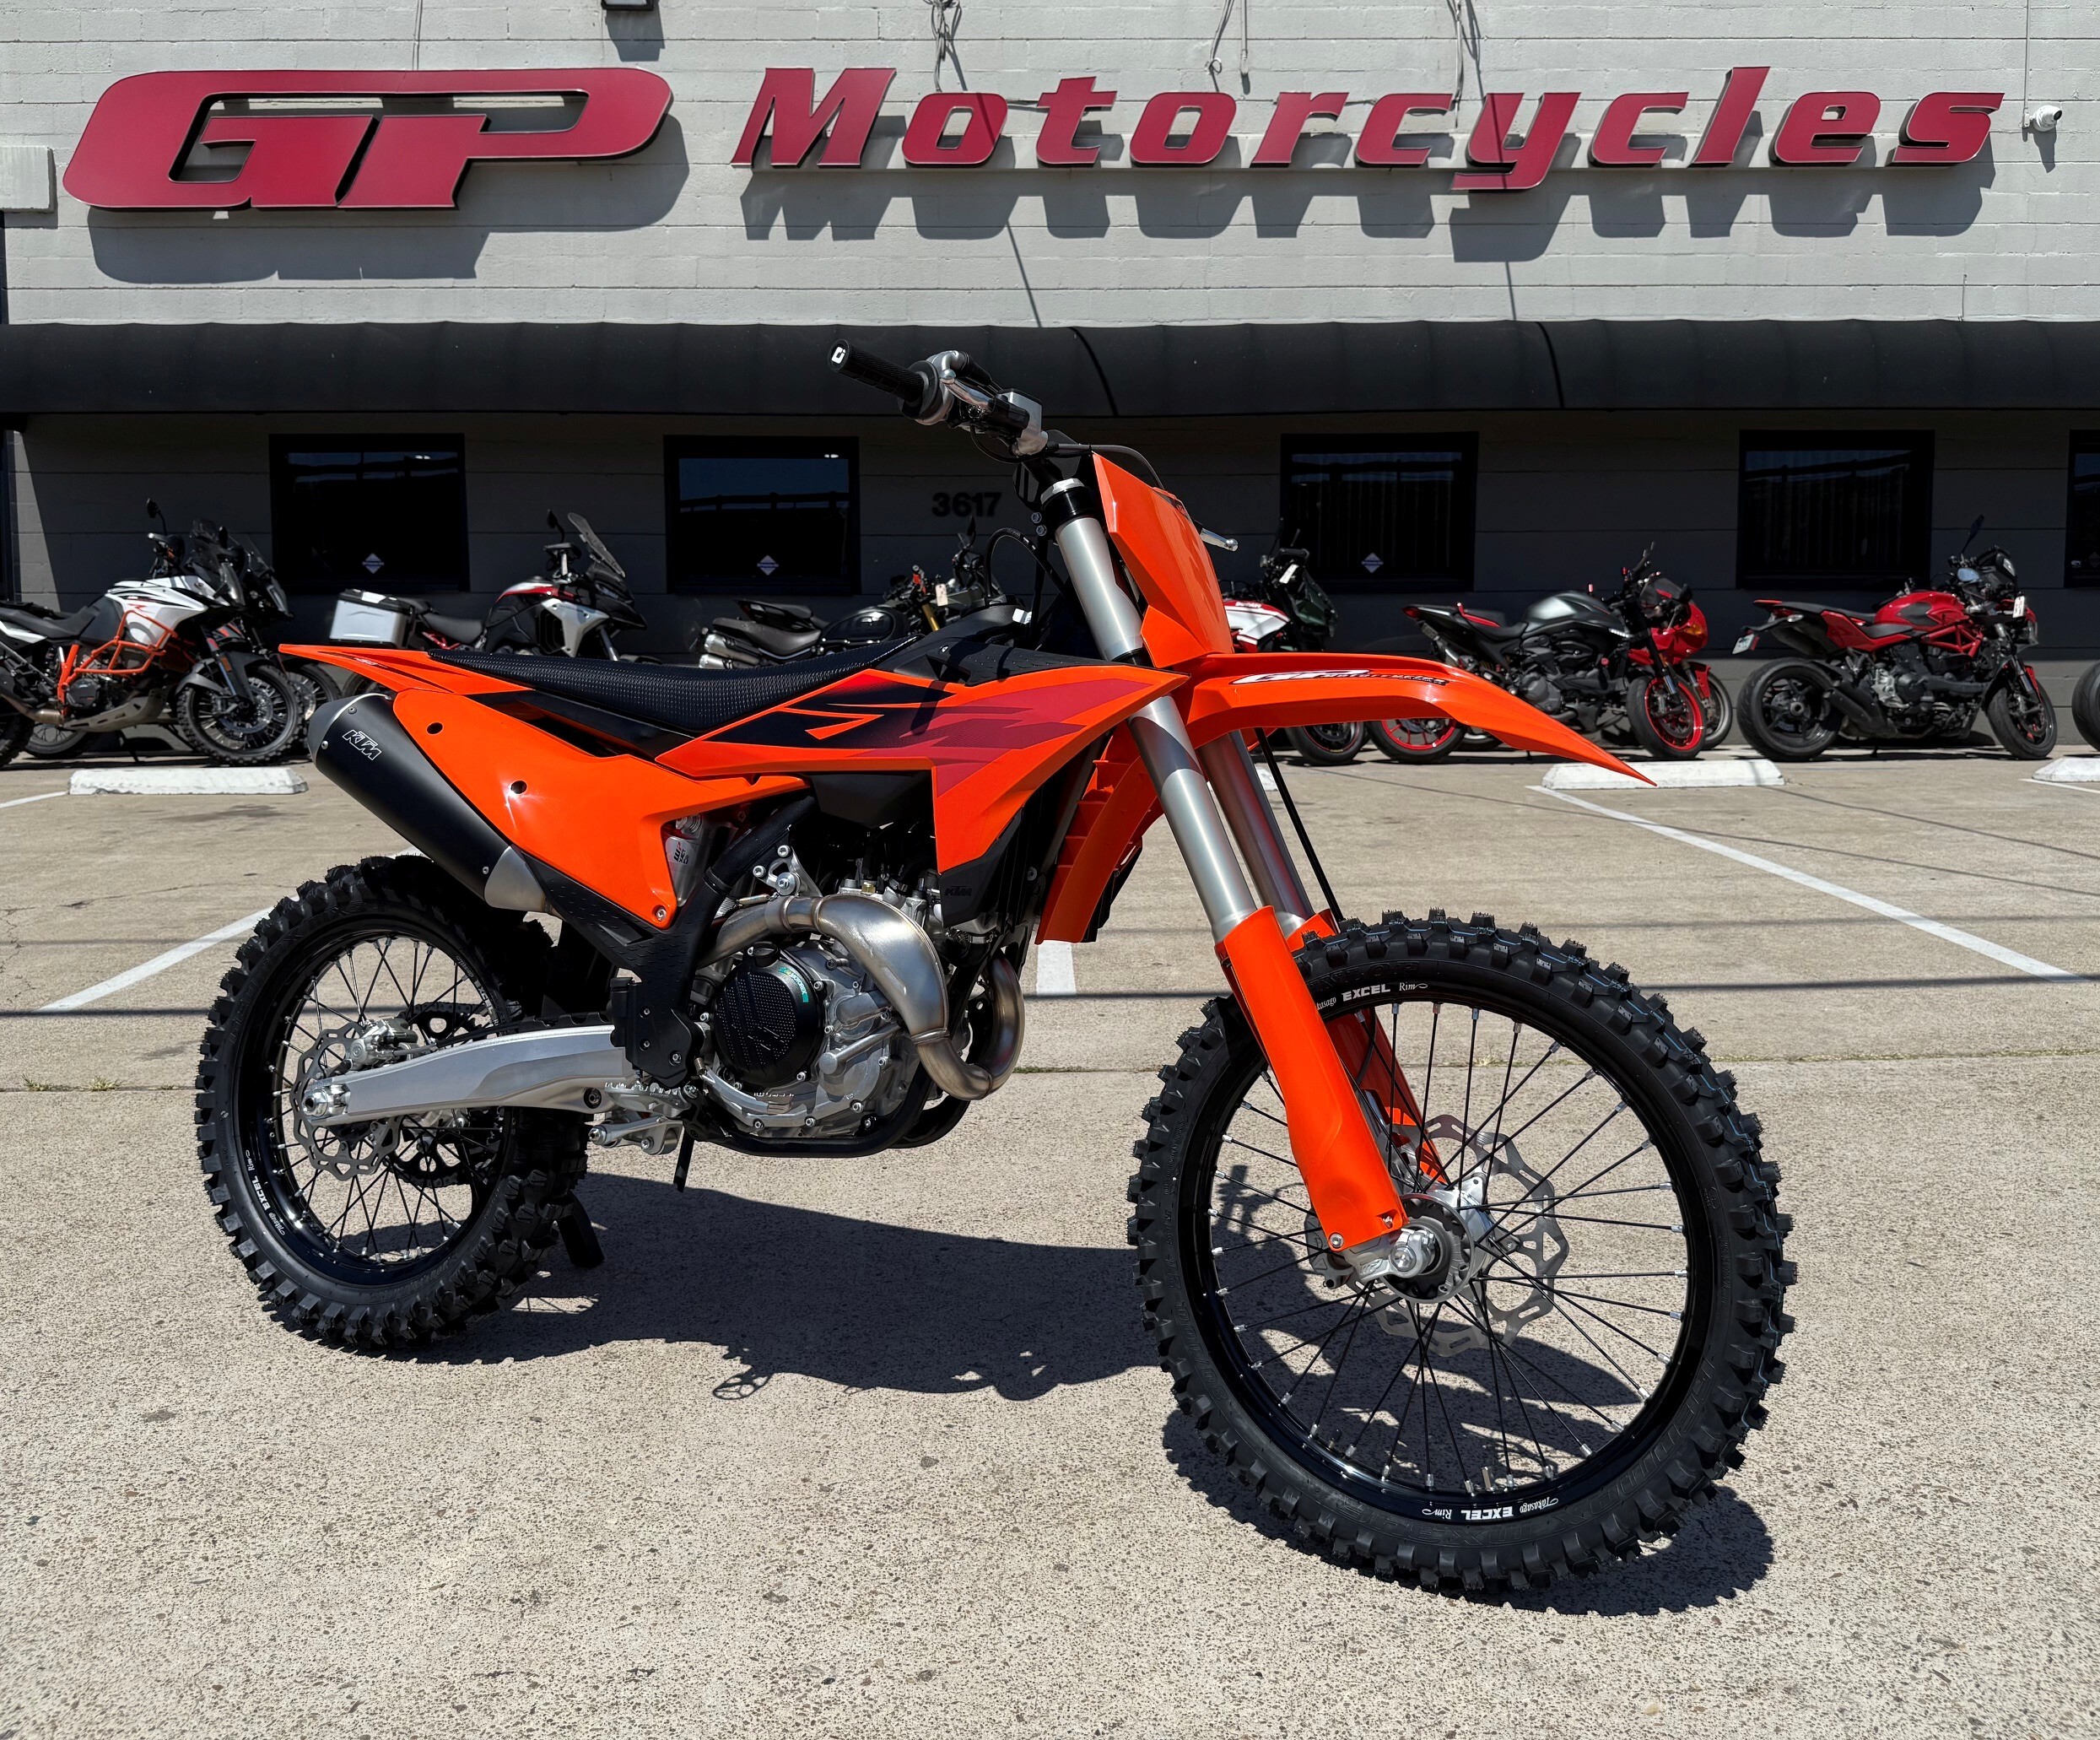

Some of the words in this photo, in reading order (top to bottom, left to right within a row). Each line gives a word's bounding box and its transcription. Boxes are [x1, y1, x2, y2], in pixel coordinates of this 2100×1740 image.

[62, 68, 673, 209] GP
[731, 64, 2006, 192] Motorcycles
[931, 492, 1002, 517] 3617
[342, 729, 382, 761] KTM
[790, 972, 808, 995] MOTOREX
[1341, 983, 1391, 1002] EXCEL
[1398, 981, 1428, 992] Rim
[251, 1175, 272, 1212] EXCEL
[1422, 1508, 1453, 1520] Rim
[1460, 1505, 1514, 1521] EXCEL
[1519, 1496, 1559, 1515] Takasago
